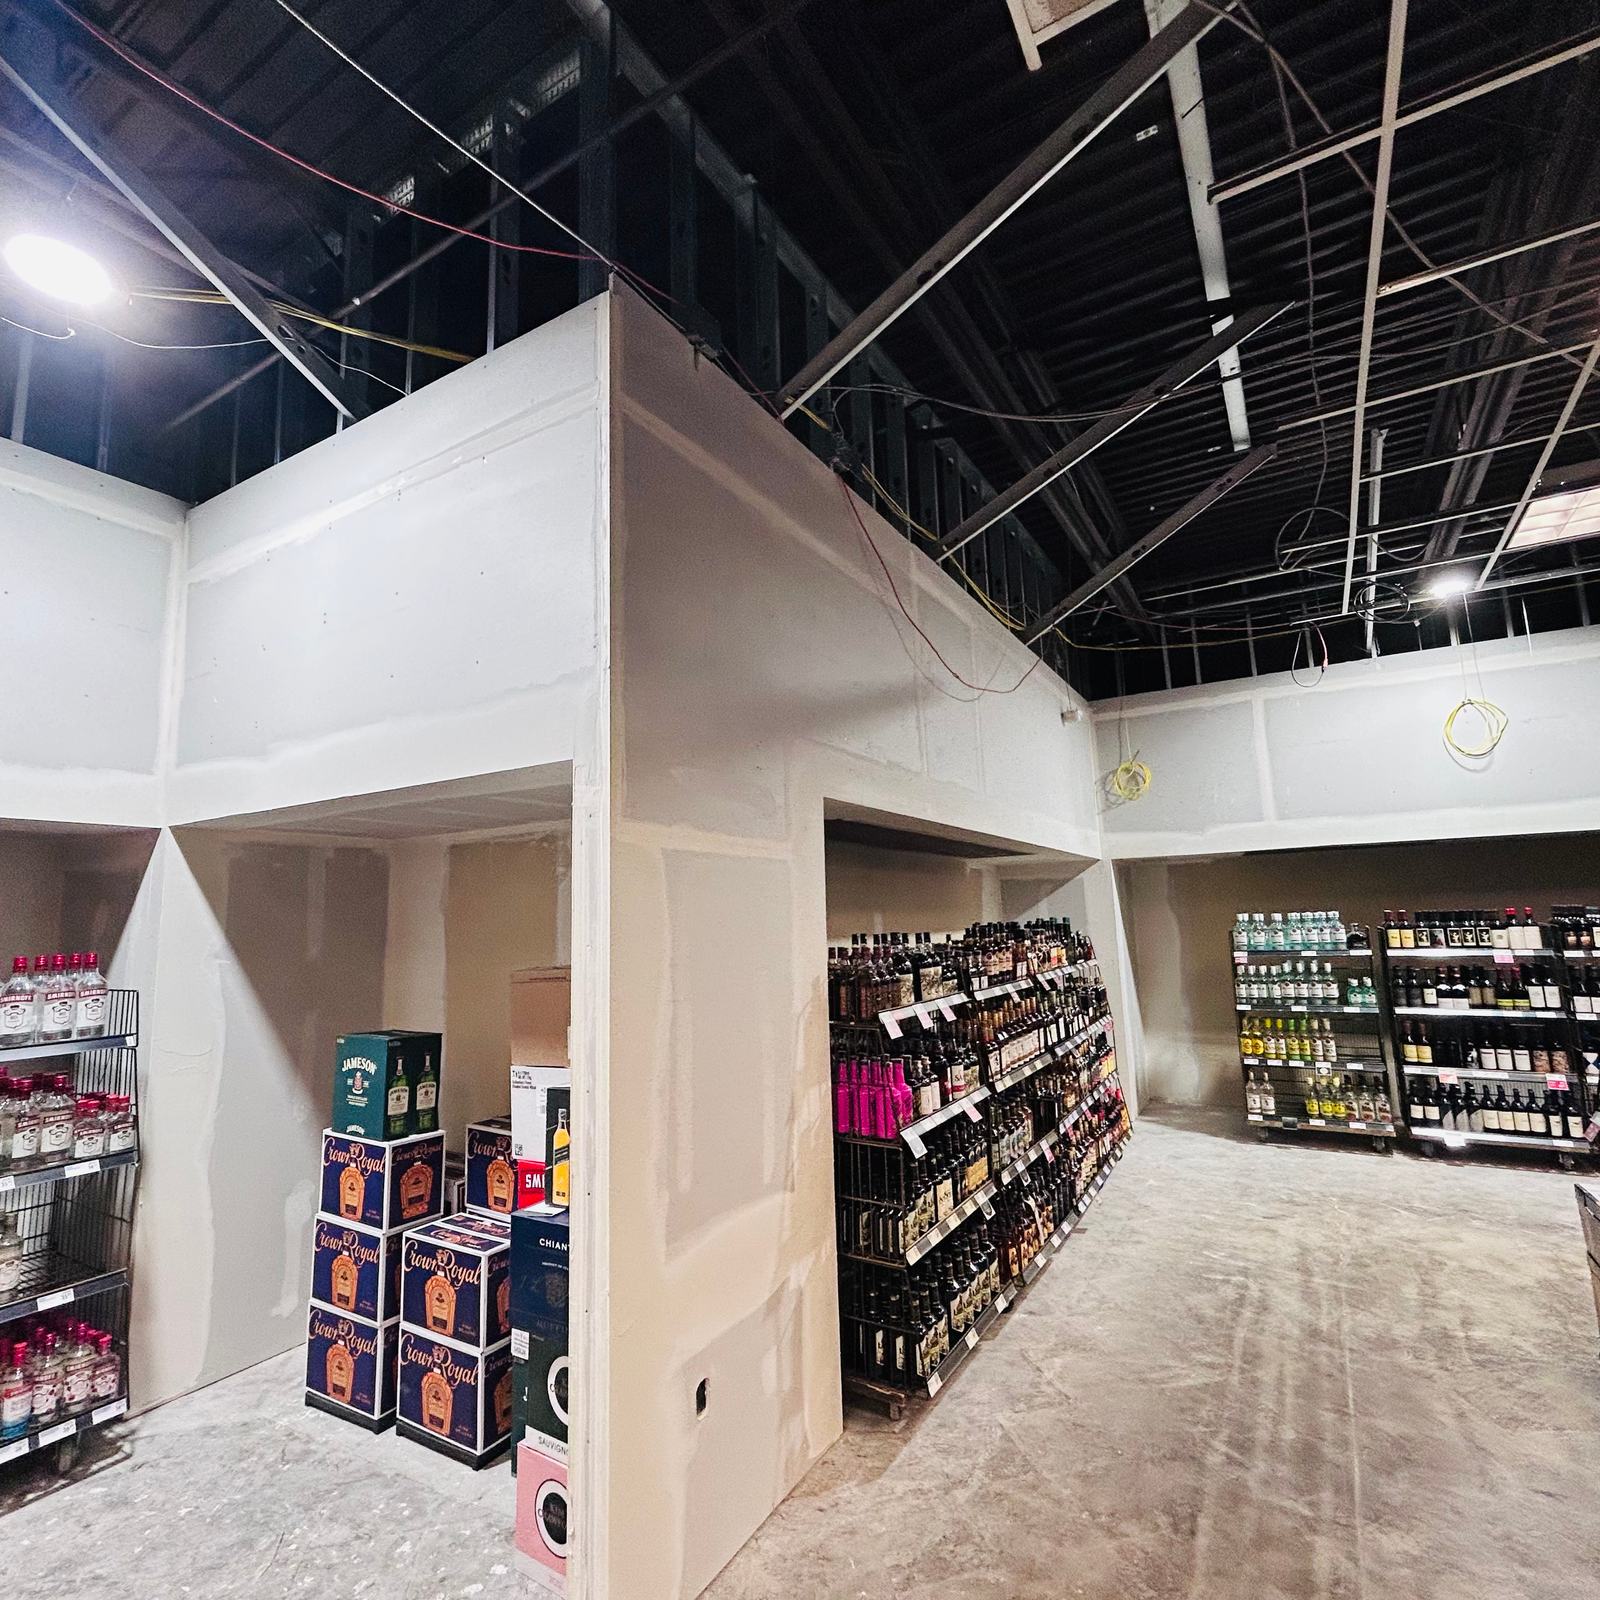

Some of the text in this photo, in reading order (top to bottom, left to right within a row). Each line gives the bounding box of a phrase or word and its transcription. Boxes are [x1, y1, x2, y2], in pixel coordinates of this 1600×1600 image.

[342, 1056, 377, 1076] JAMESON
[323, 1136, 387, 1179] Crown Royal
[467, 1130, 497, 1160] Crown
[315, 1221, 381, 1269] Crown Royal
[404, 1239, 482, 1290] Crown Royal
[539, 1237, 570, 1252] CHIAN
[308, 1308, 378, 1360] Crown Royal
[400, 1332, 479, 1389] Crown Royal
